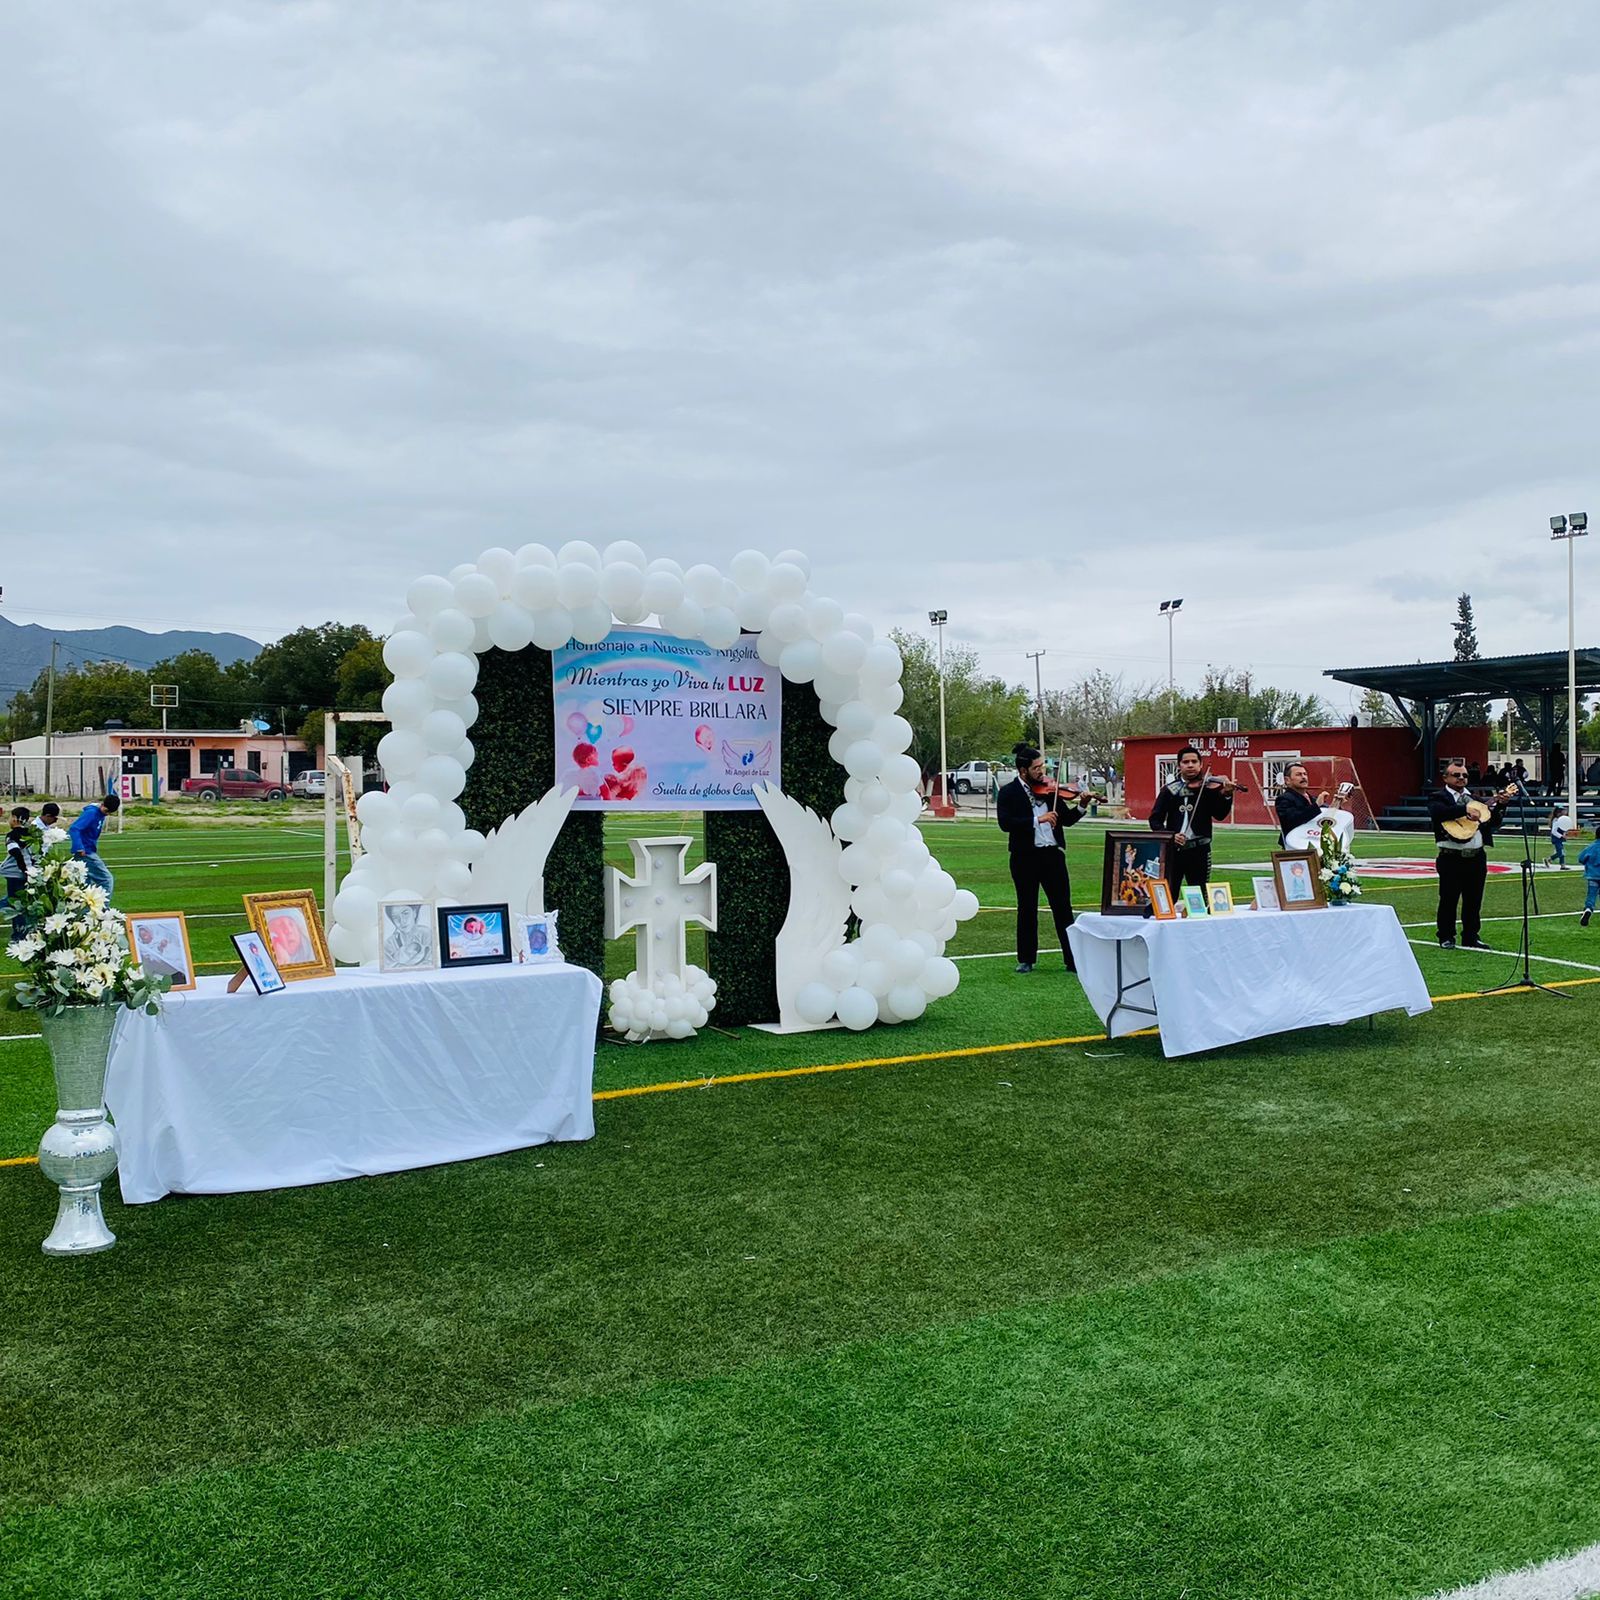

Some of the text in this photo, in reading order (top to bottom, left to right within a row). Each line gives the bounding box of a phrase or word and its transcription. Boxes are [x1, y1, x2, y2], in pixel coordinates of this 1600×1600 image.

[565, 636, 760, 663] Homenaje a Nuestros Angelito
[566, 666, 765, 692] Mientras yo Viva tu LUZ
[602, 698, 768, 720] SIEMPRE BRILLARA
[120, 738, 196, 747] PALETERIA
[1189, 737, 1249, 749] SALA DE JUNTAS
[733, 769, 751, 778] Angel
[652, 781, 687, 796] Suelta
[689, 783, 702, 795] de
[702, 782, 731, 798] globos
